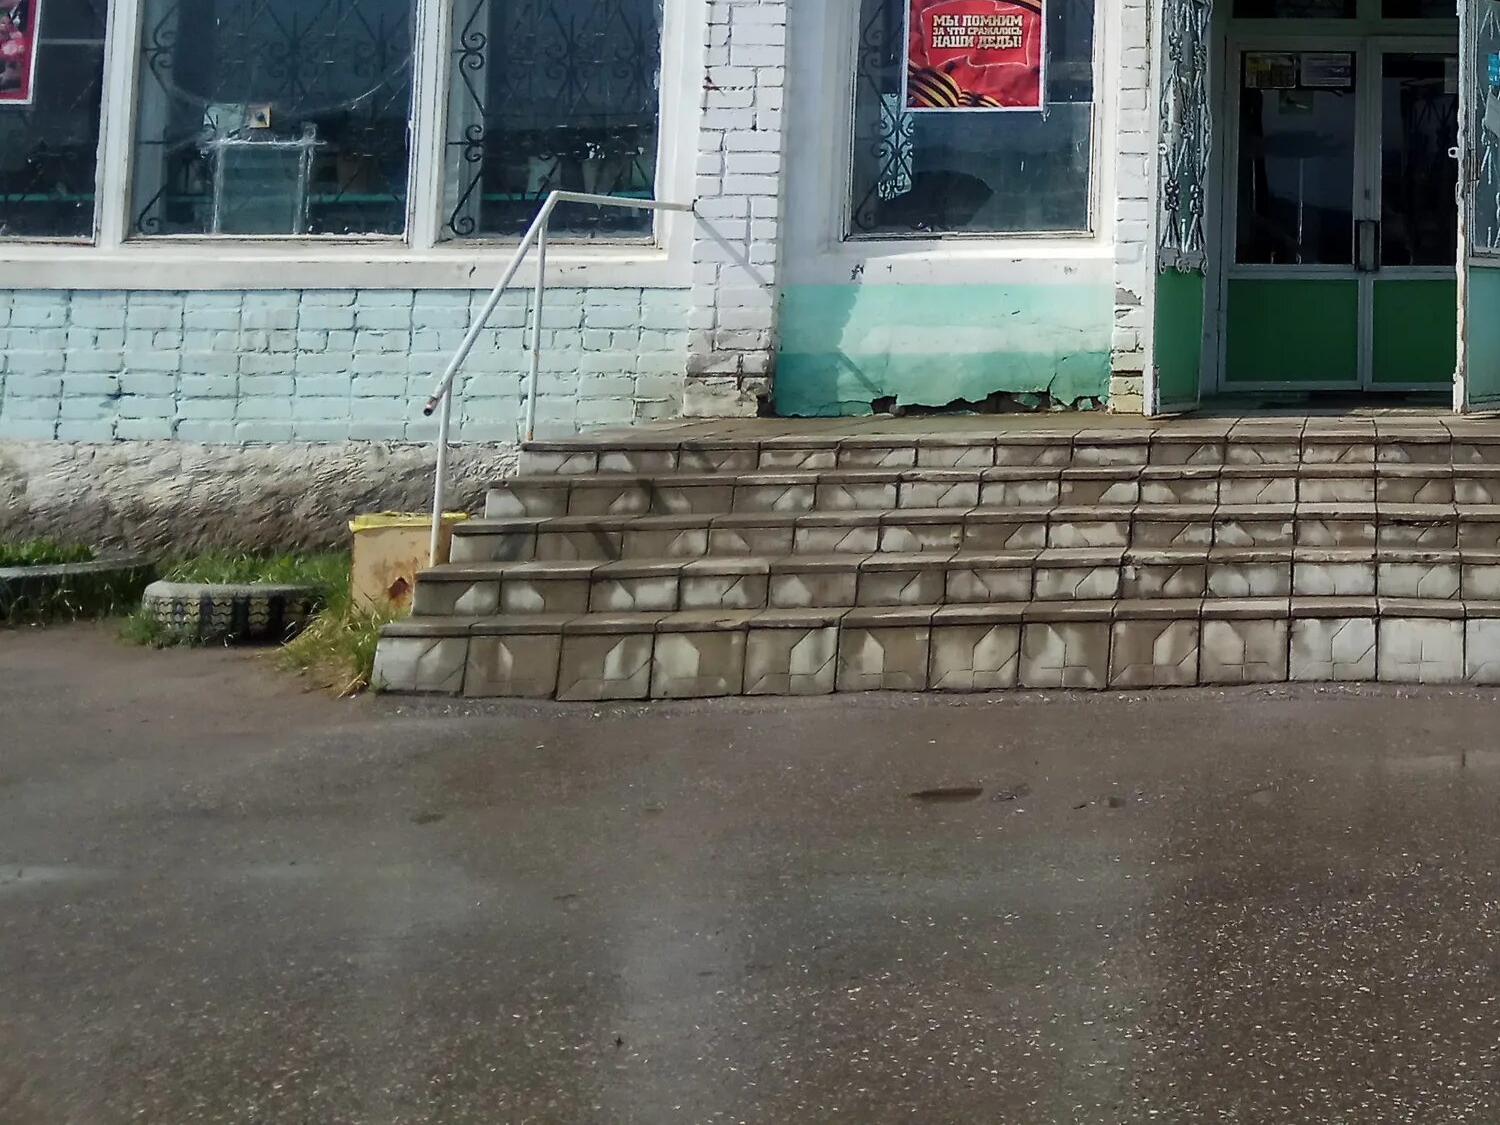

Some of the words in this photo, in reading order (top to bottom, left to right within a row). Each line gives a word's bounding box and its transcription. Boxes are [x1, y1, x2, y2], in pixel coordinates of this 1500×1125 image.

[933, 15, 959, 26] МЫ
[962, 15, 1023, 26] ПОМНИМ
[932, 36, 974, 48] НАШИ
[977, 36, 1022, 49] ДЕДЫ!
